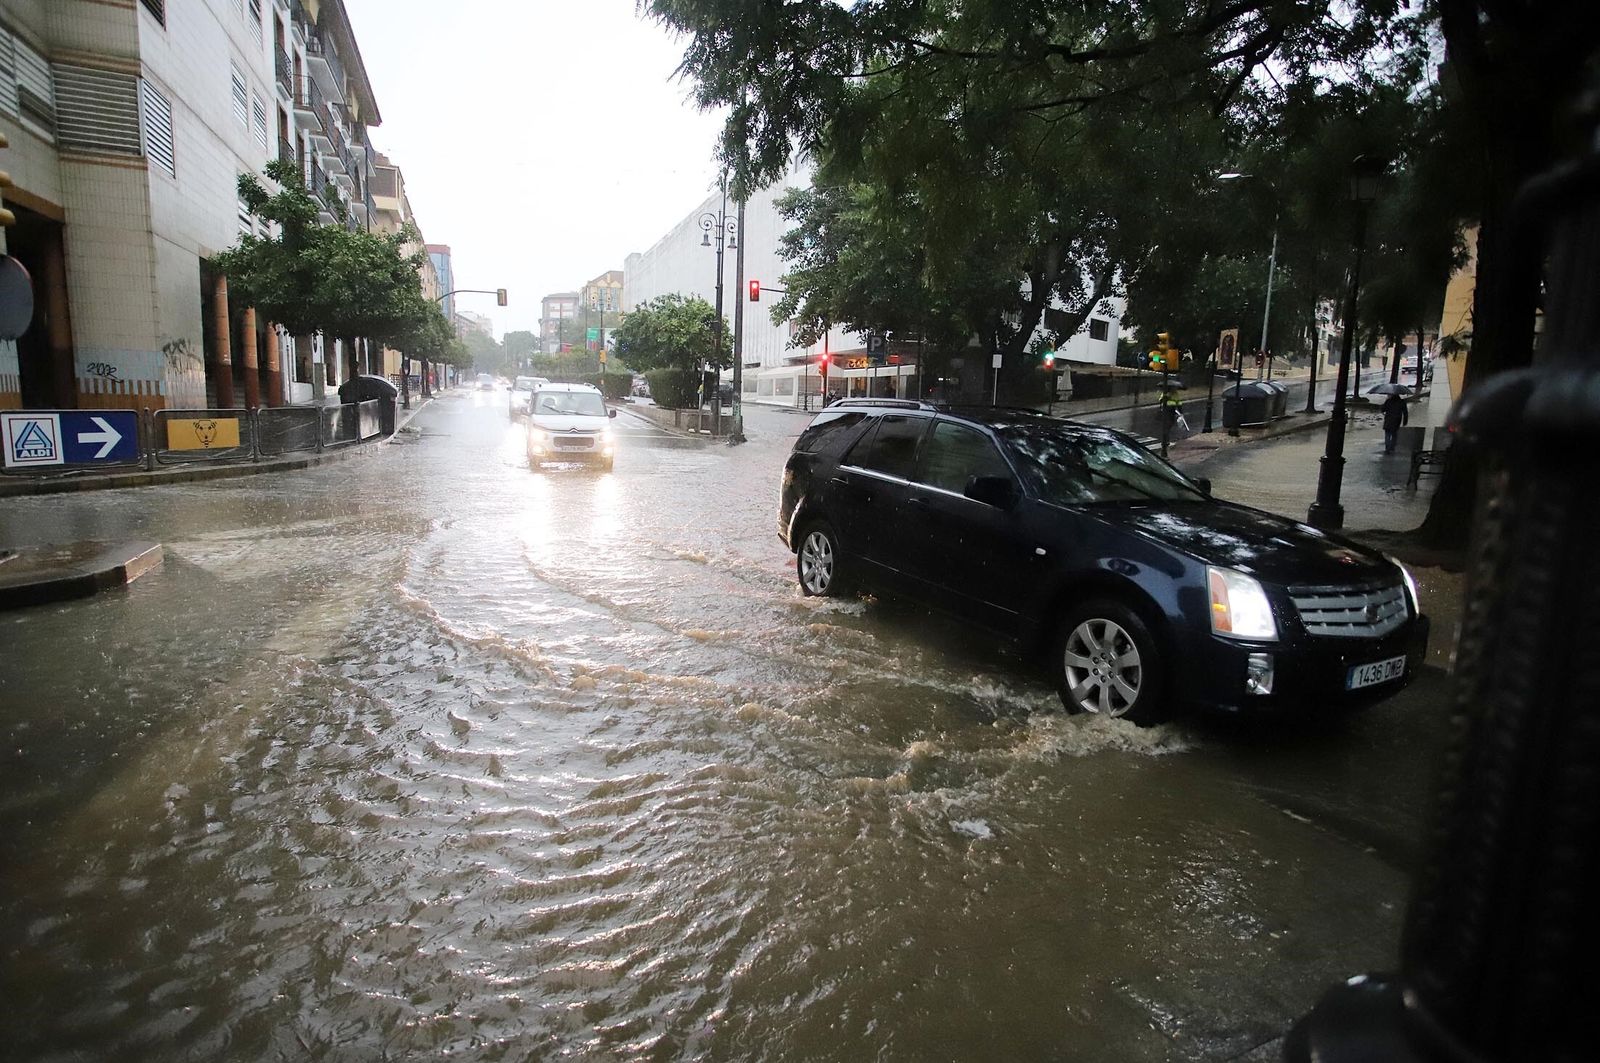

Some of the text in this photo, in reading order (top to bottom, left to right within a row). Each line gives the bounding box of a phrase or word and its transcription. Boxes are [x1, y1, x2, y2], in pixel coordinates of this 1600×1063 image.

[870, 337, 882, 352] P
[20, 449, 51, 458] ALDI
[1359, 664, 1383, 685] 1436
